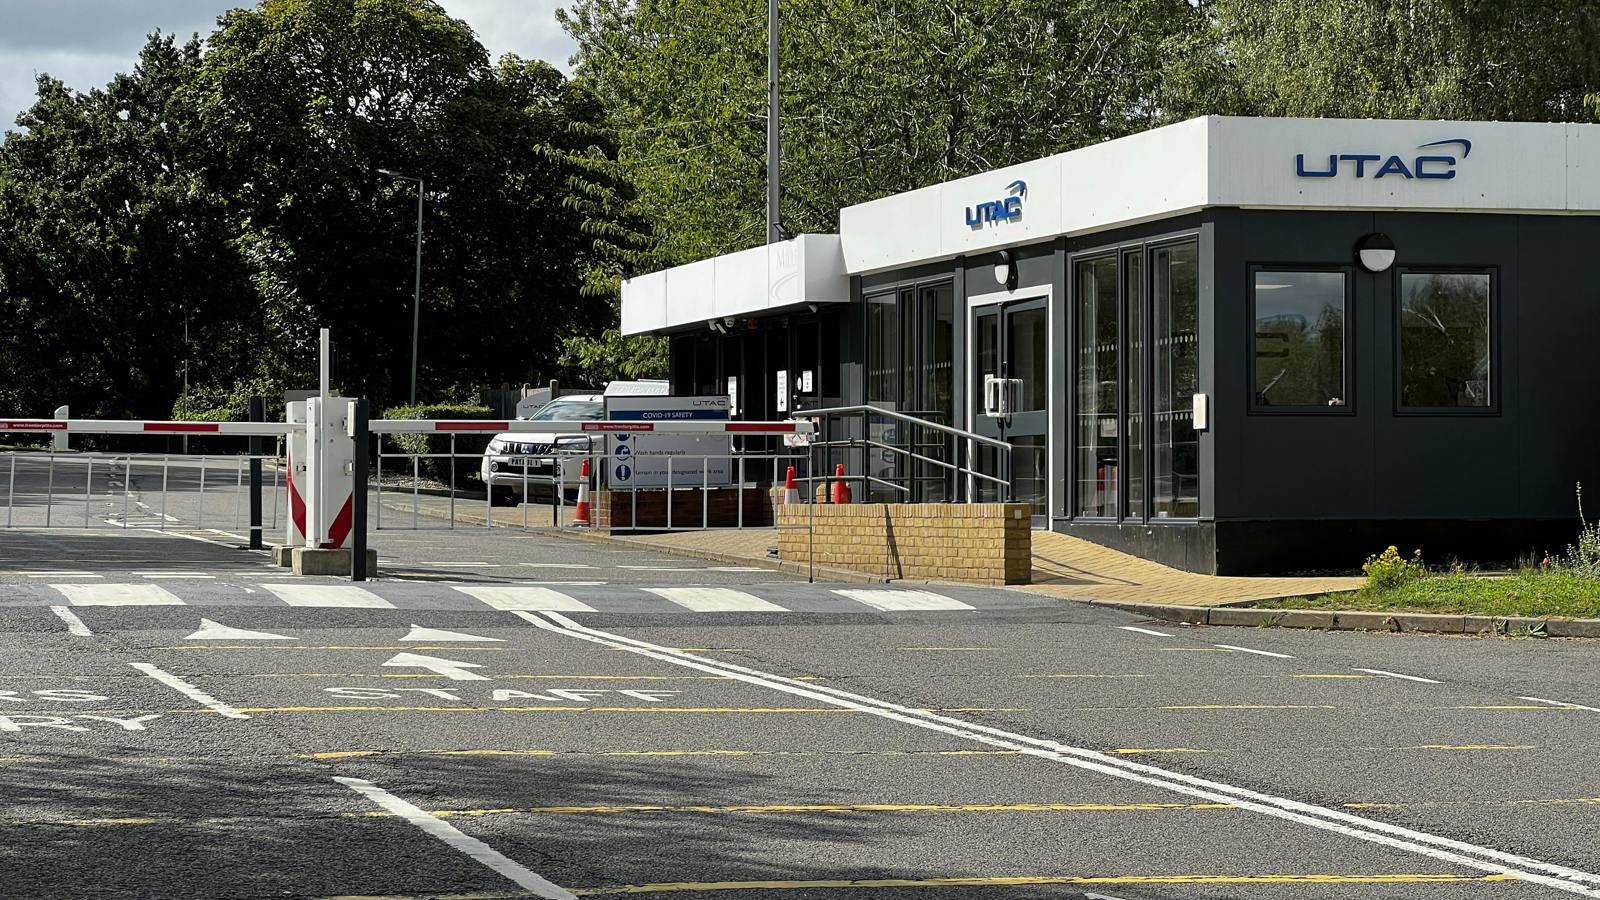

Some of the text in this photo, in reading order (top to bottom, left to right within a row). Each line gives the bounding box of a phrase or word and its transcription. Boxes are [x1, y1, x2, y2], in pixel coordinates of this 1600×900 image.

[1296, 151, 1458, 180] UTAC
[965, 195, 1023, 226] UTAC
[642, 411, 671, 419] COVID-19
[323, 687, 682, 701] STAFF
